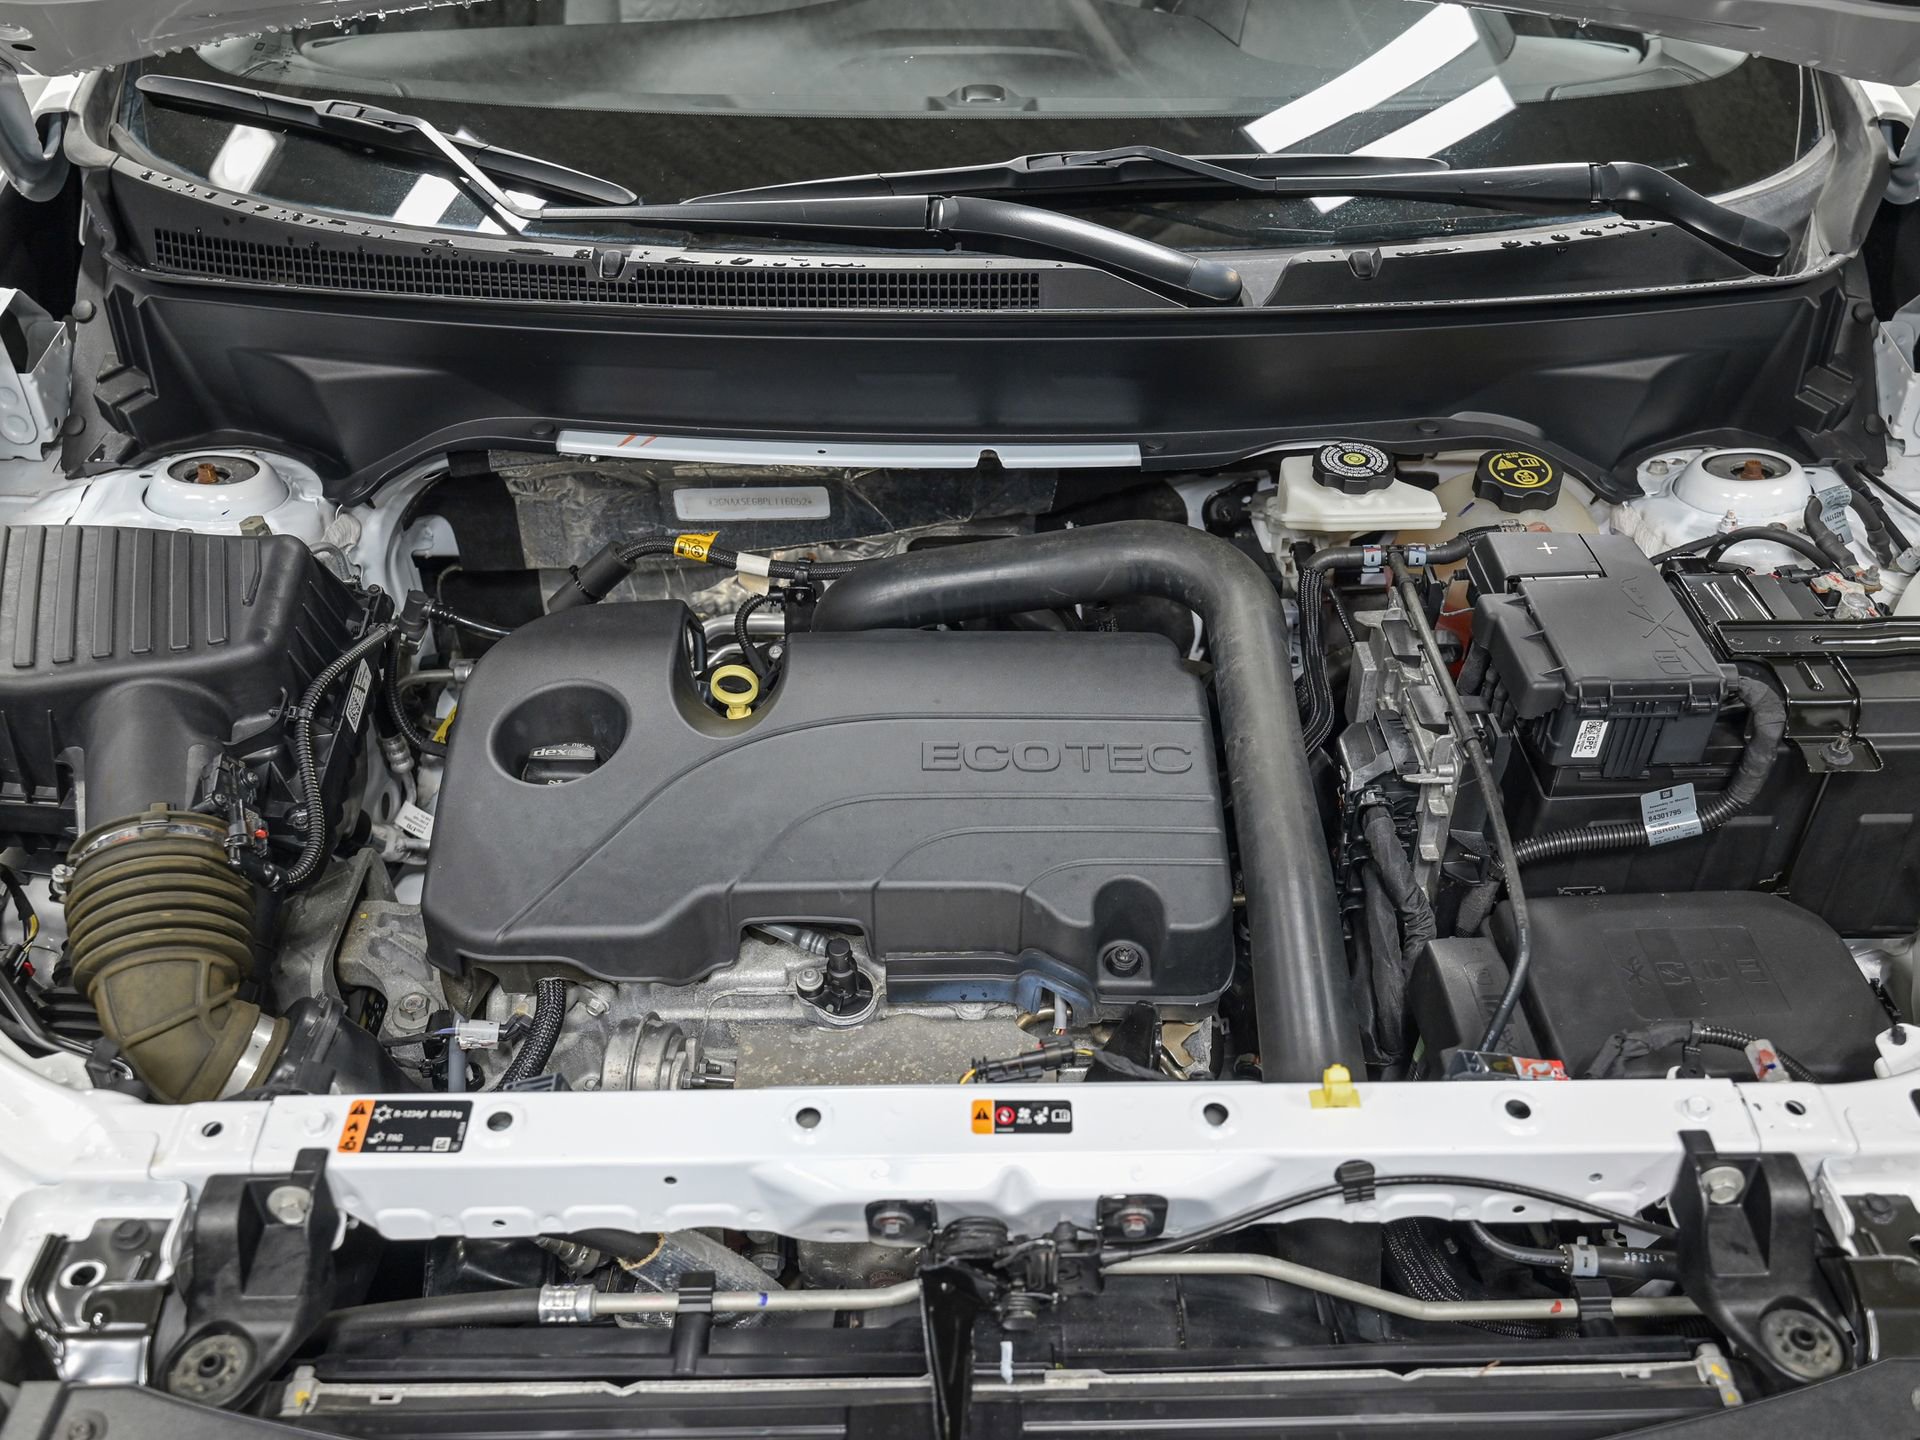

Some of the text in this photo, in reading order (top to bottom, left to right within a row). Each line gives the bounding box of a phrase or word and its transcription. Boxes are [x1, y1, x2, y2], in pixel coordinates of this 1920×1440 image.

[1584, 736, 1596, 750] GPC
[921, 740, 1193, 774] ECOTEC
[1648, 809, 1681, 822] 84301795
[386, 1133, 404, 1143] PAG
